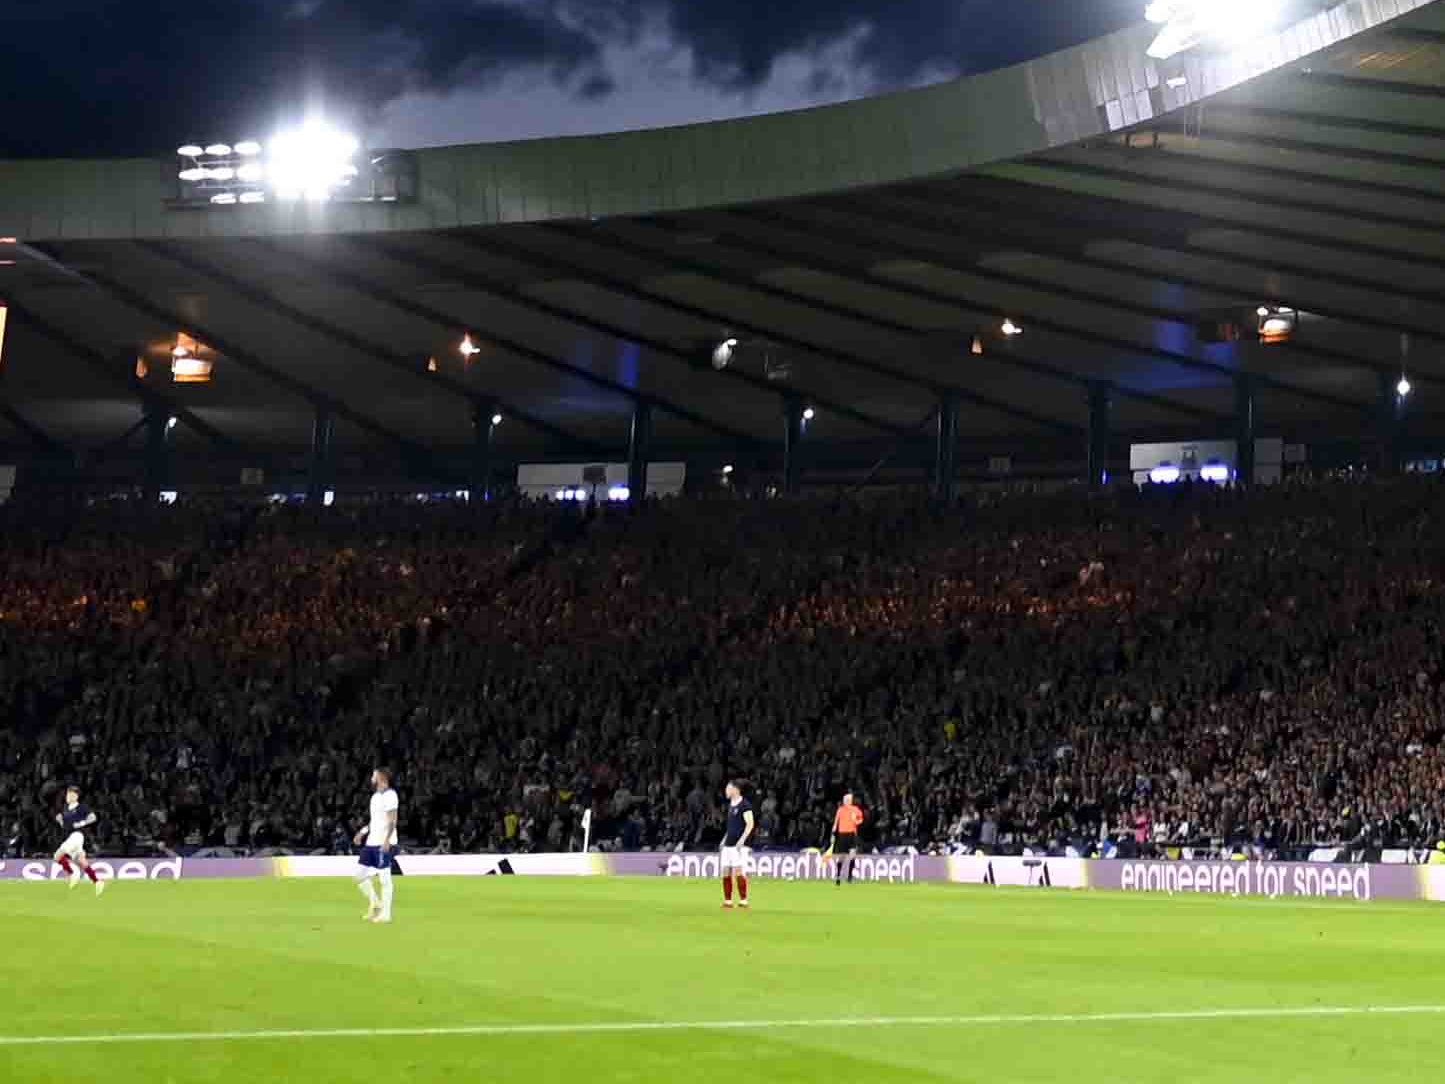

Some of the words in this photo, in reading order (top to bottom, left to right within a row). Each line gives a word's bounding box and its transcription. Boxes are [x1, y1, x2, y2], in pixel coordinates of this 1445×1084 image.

[667, 852, 811, 880] engeered
[1120, 860, 1250, 894] engineered
[1255, 860, 1288, 897] for
[1294, 862, 1370, 900] speed
